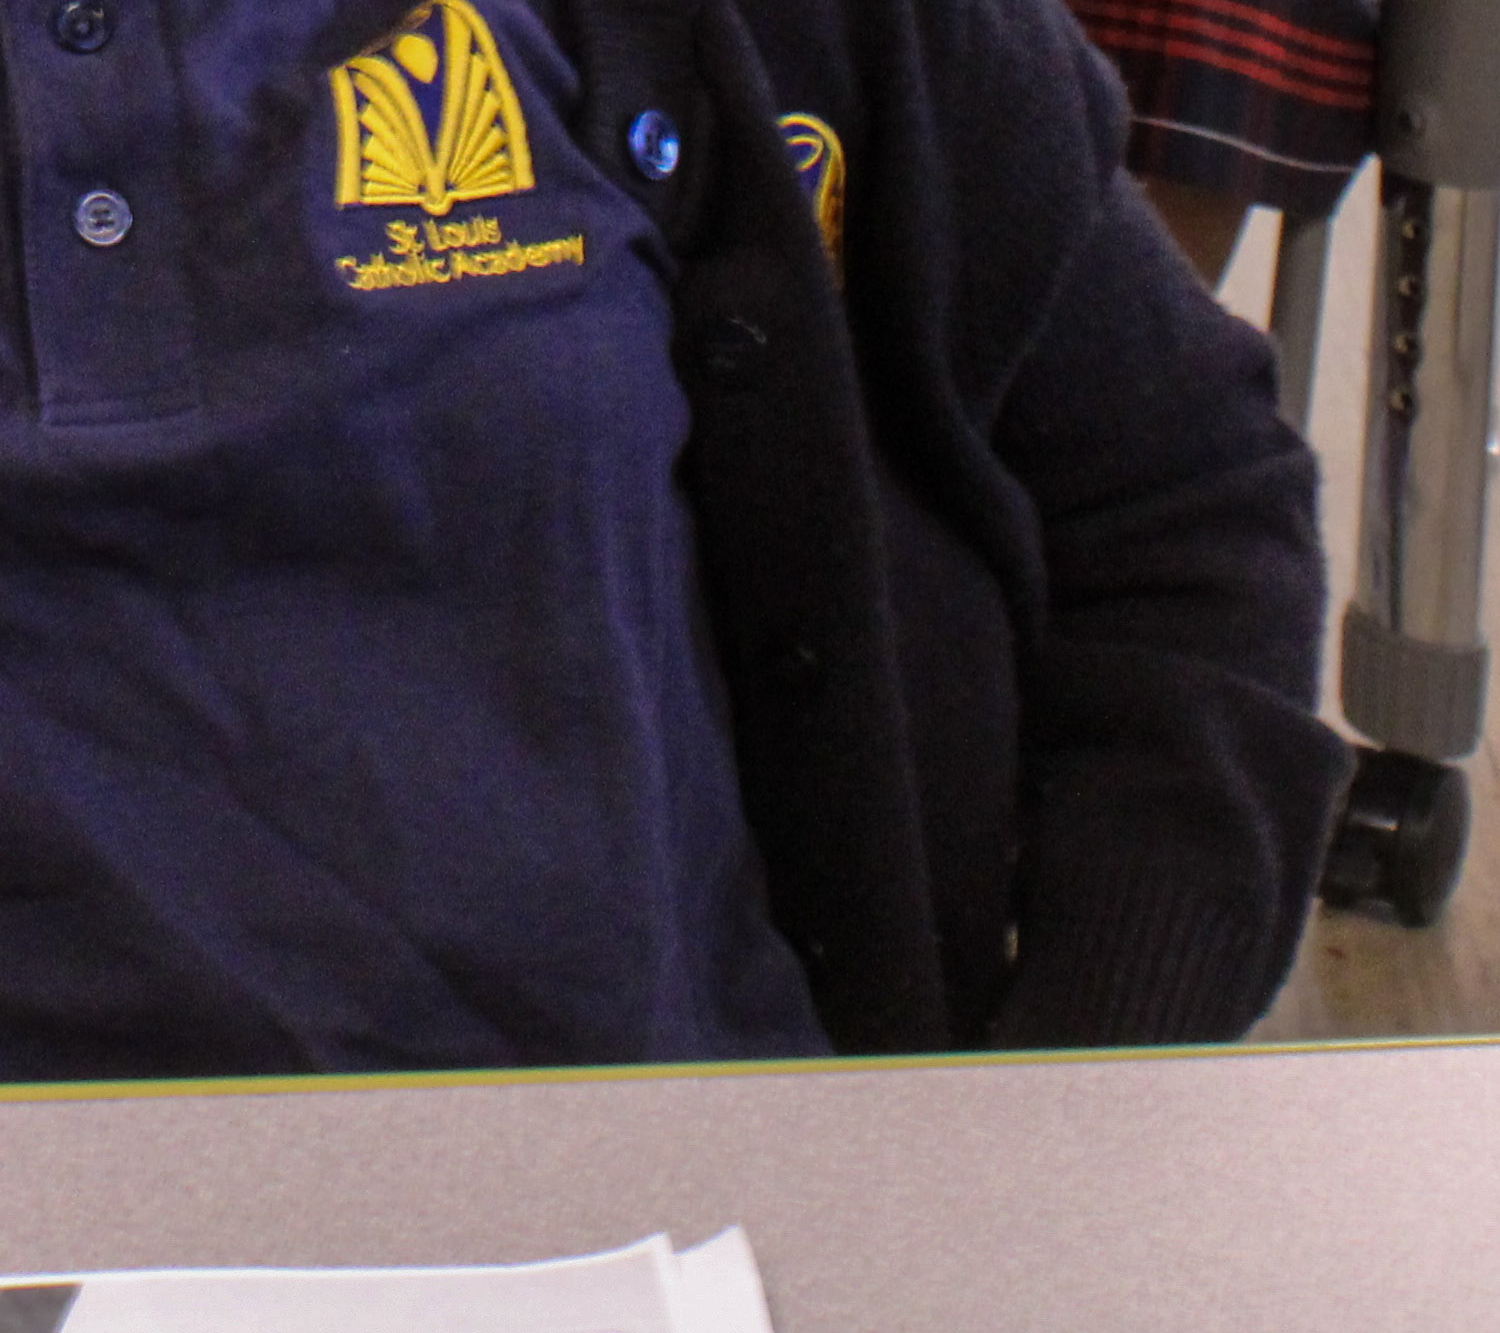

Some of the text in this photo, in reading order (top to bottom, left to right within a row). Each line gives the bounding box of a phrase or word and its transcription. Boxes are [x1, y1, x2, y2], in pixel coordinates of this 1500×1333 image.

[423, 215, 502, 252] Louis
[335, 234, 585, 291] Catholic Academy
